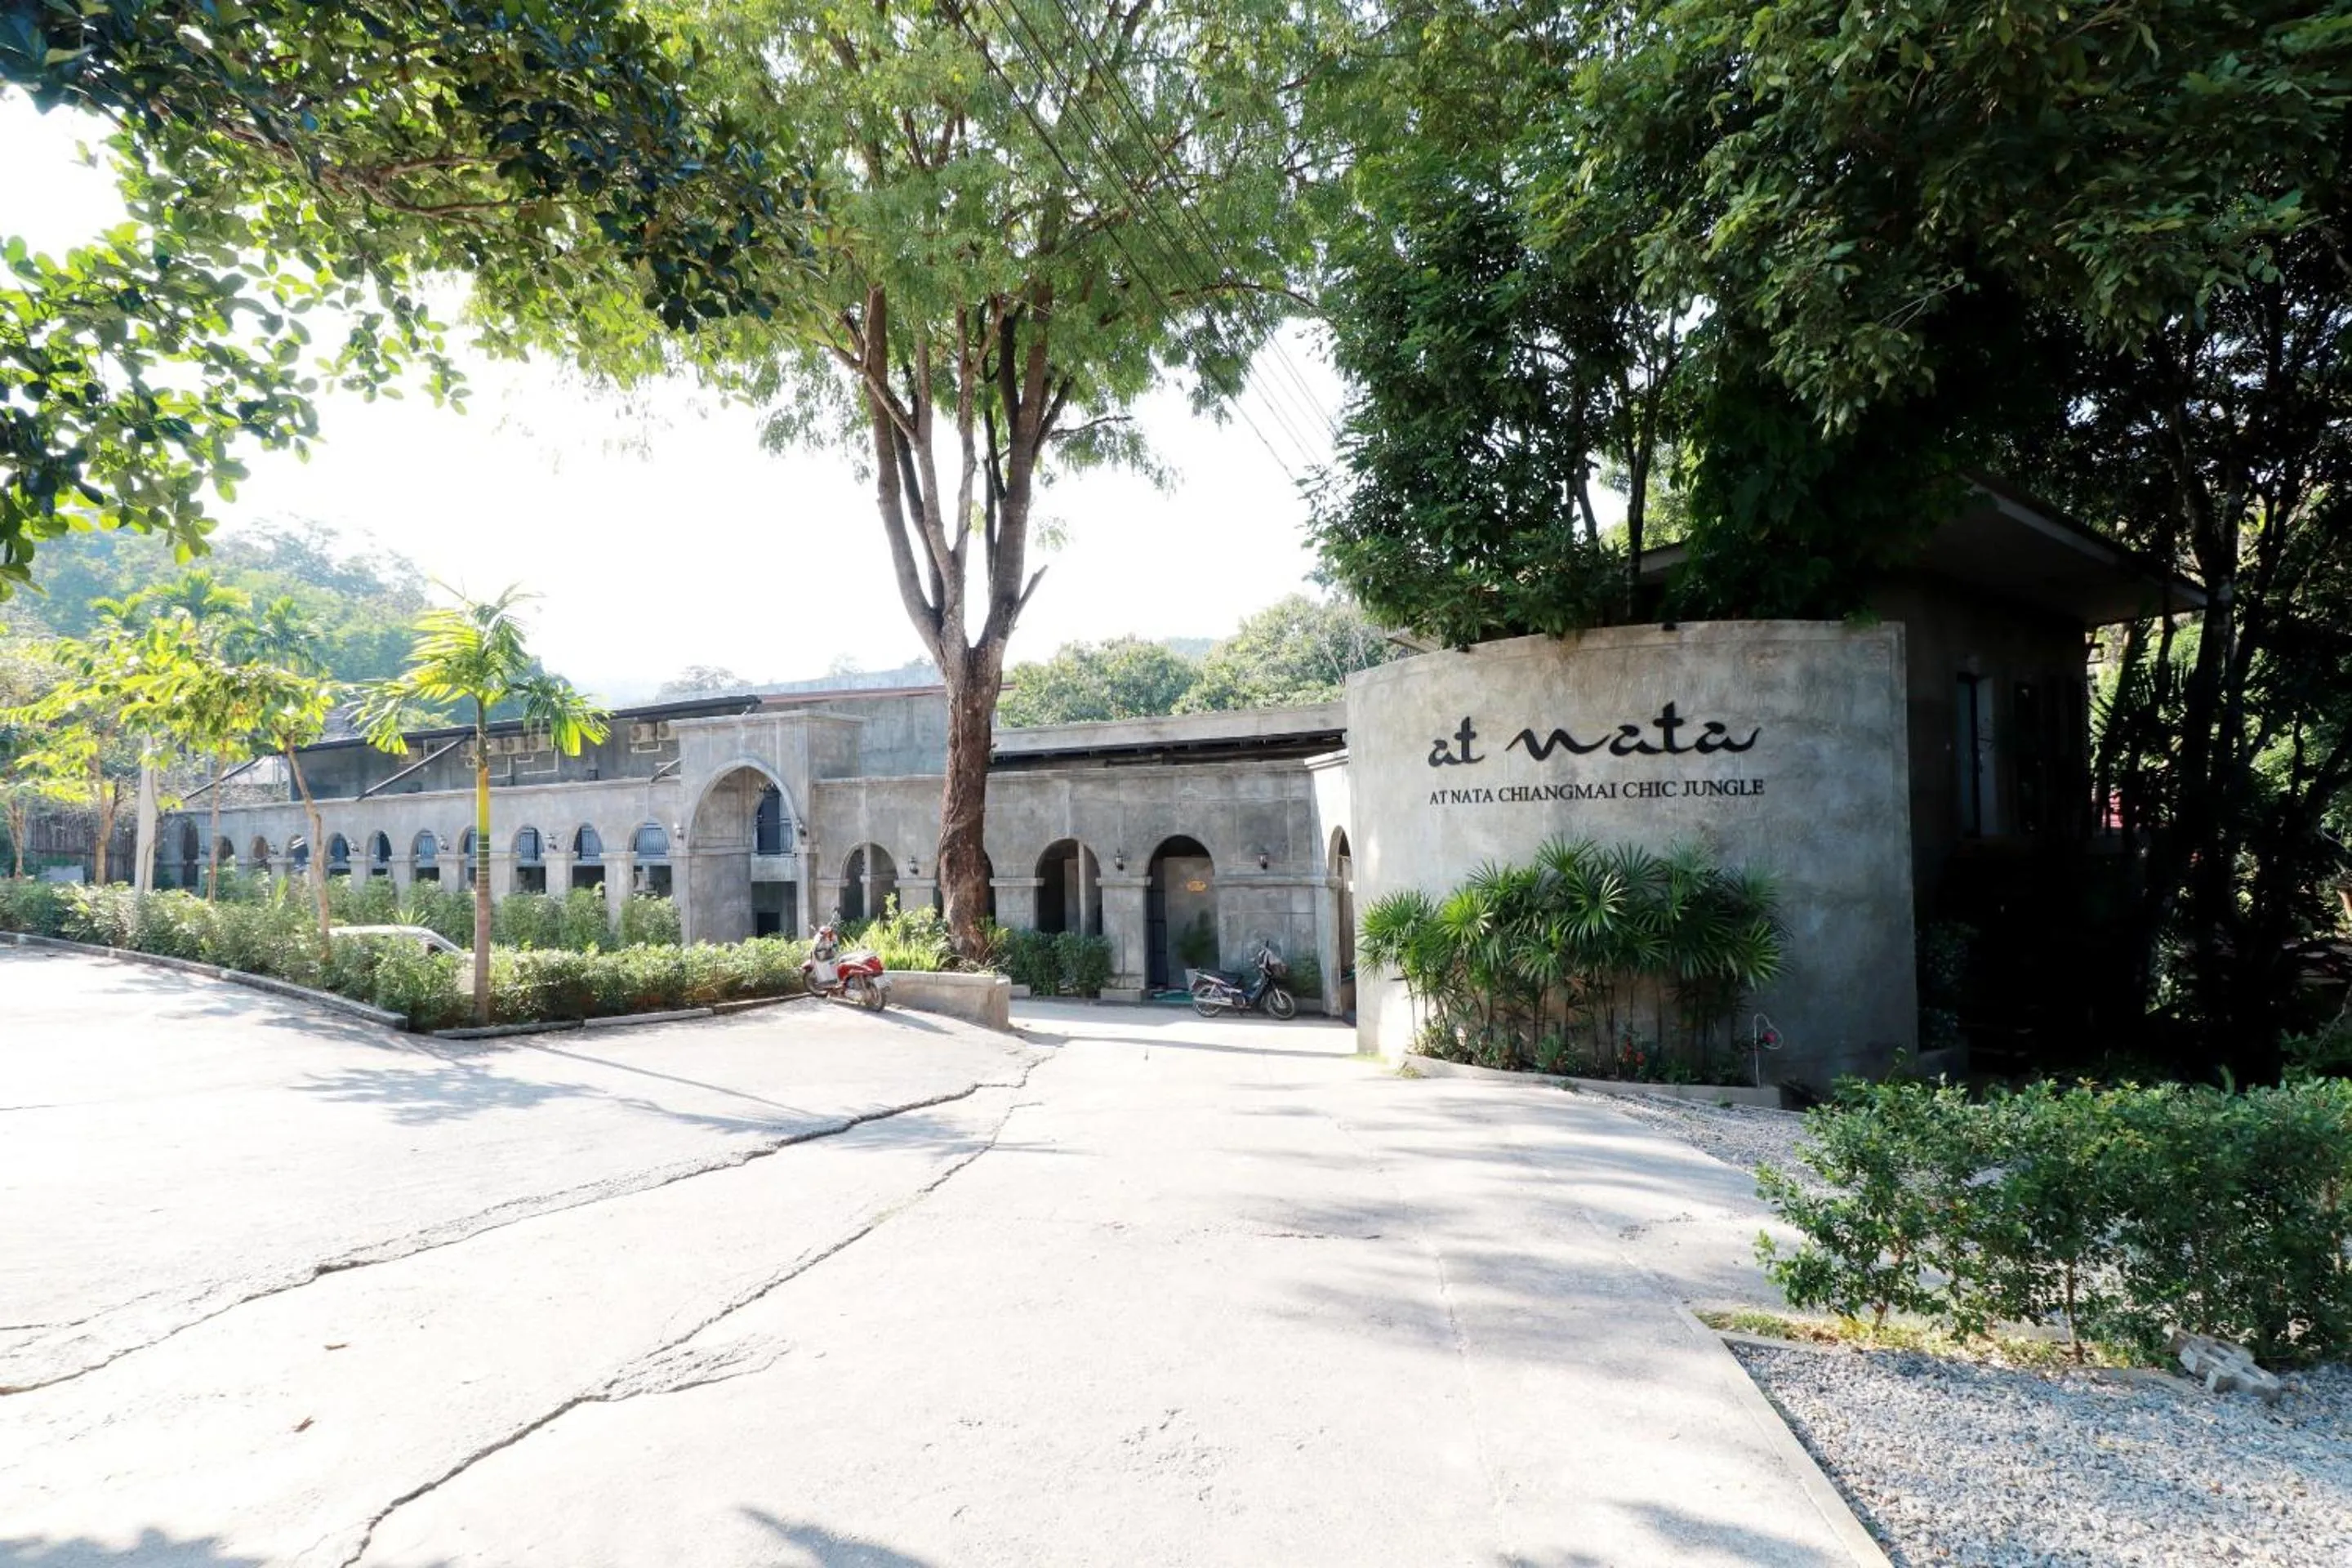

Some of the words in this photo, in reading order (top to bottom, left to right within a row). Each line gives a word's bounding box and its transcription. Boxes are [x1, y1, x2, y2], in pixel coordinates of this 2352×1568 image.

[1428, 716, 1485, 767] at
[1505, 701, 1762, 761] nata
[1429, 791, 1446, 805] AT
[1451, 789, 1494, 804] NATA
[1498, 782, 1617, 803] CHIANGMAI
[1622, 780, 1677, 798] CHIC
[1682, 778, 1765, 797] JUNGLE
